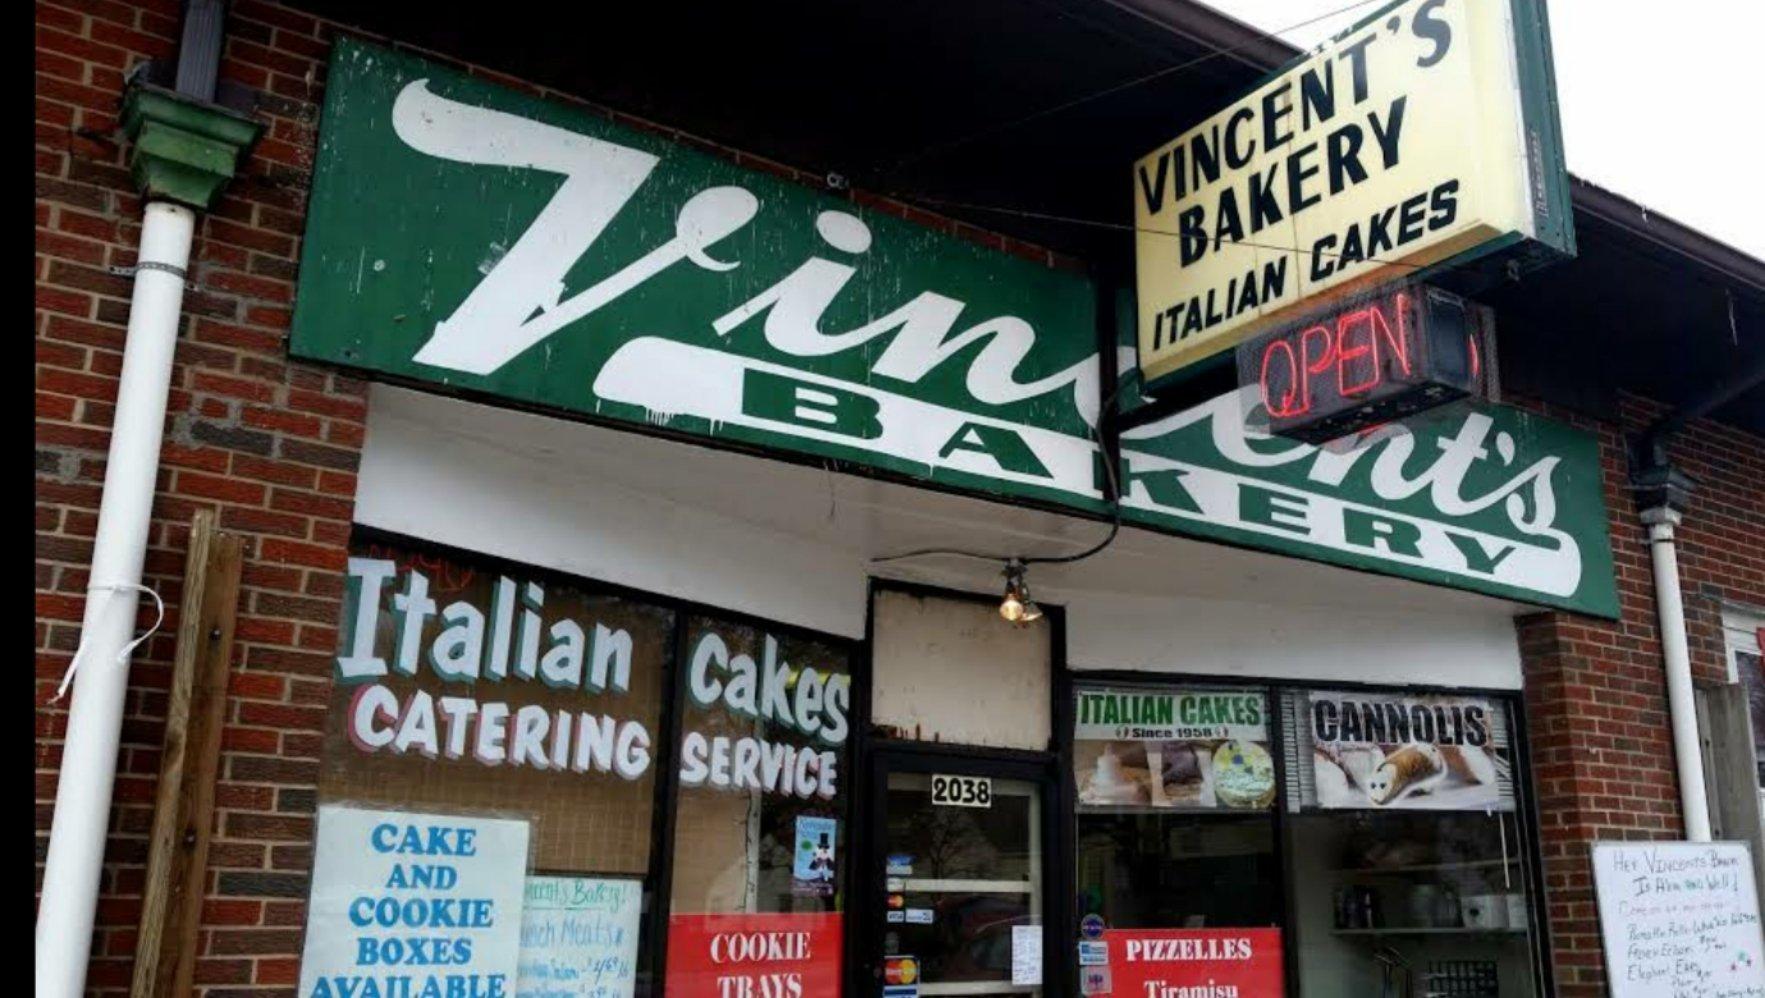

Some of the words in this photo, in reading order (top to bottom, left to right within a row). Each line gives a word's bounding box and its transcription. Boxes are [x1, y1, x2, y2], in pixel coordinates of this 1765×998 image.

[1138, 0, 1452, 216] VINCENT'S
[1178, 95, 1408, 268] BAKERY
[1152, 256, 1287, 352] ITALIAN
[1309, 179, 1459, 283] CAKES
[1260, 293, 1412, 418] OPEN
[742, 367, 1518, 576] BAKERY
[334, 557, 633, 693] Italian
[687, 633, 850, 745] Cakes
[1081, 694, 1173, 724] ITALIAN
[1179, 696, 1261, 725] CAKES
[1314, 698, 1489, 747] CANNOLIS
[347, 683, 651, 780] CATERING
[678, 730, 838, 799] SERVICE
[1132, 727, 1173, 738] Since
[1177, 727, 1212, 738] 1958
[933, 777, 990, 805] 2038
[370, 823, 477, 857] CAKE
[385, 864, 458, 890] AND
[348, 896, 494, 928] COOKIE
[355, 937, 472, 966] BOXES
[709, 931, 811, 964] COOKIE
[1125, 938, 1254, 961] PIZZELLES
[310, 973, 506, 998] AVAILABLE
[716, 972, 803, 998] TRAYS
[1143, 978, 1239, 998] Tiramisu
